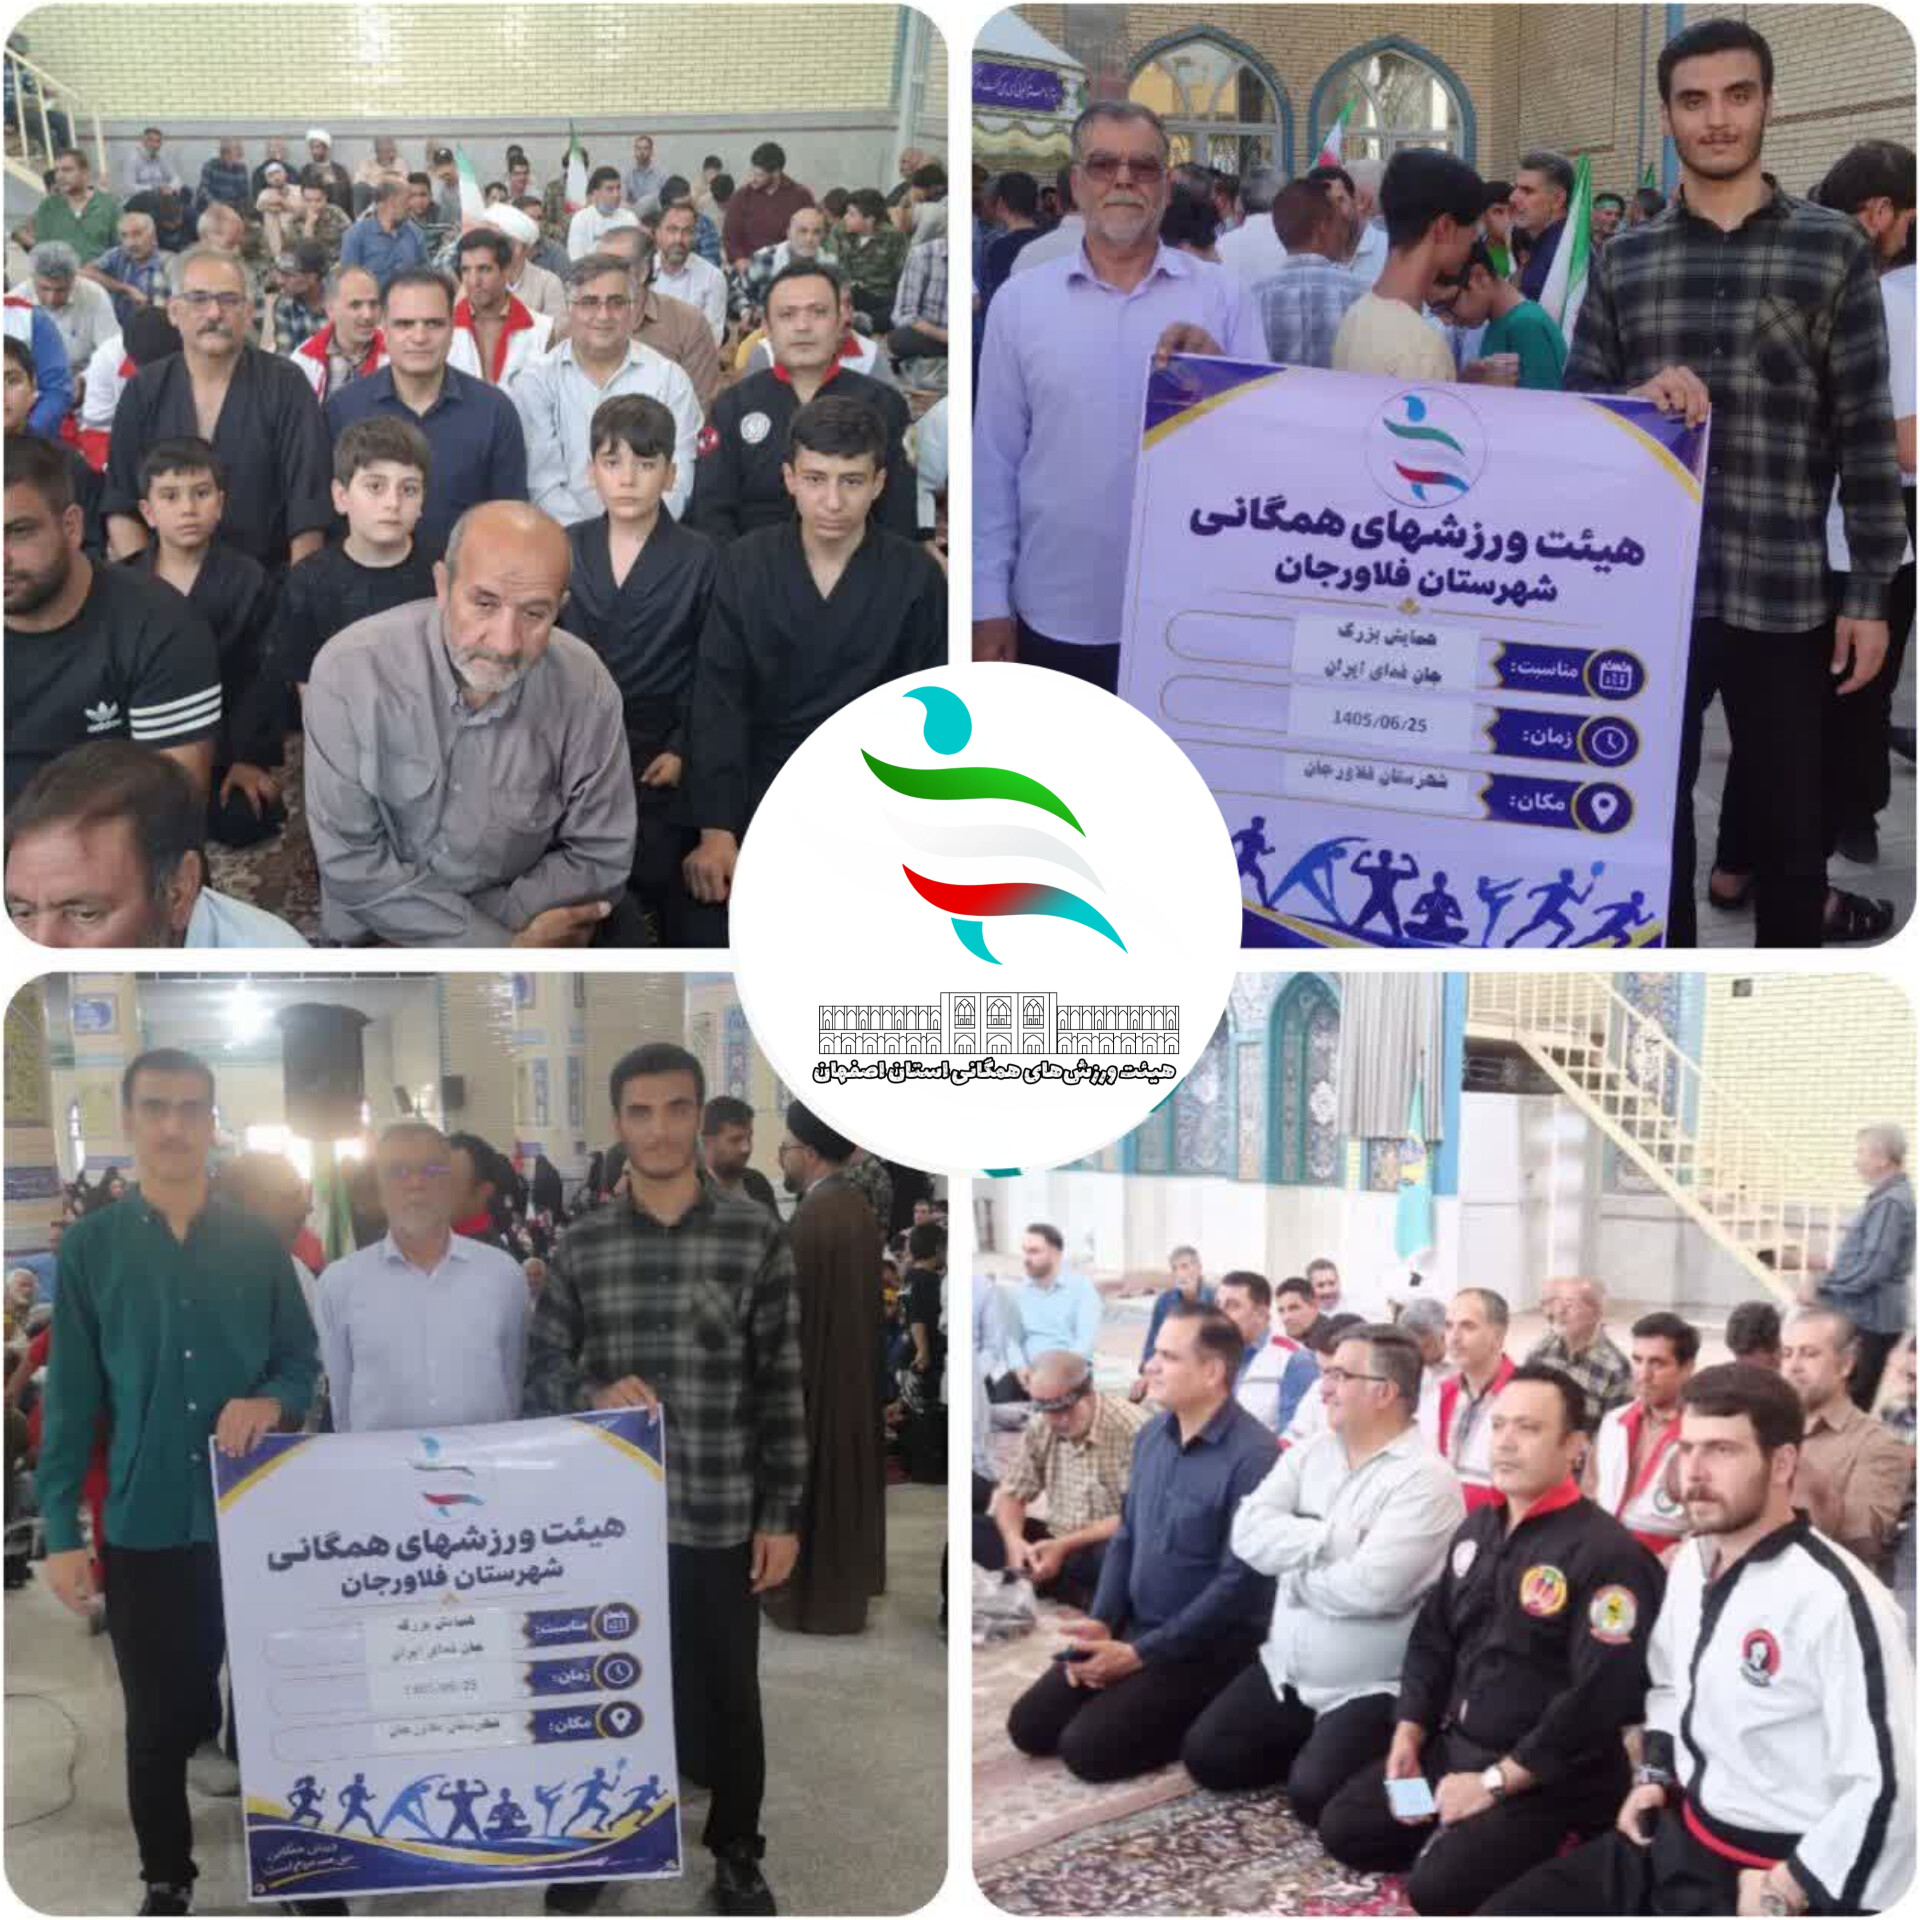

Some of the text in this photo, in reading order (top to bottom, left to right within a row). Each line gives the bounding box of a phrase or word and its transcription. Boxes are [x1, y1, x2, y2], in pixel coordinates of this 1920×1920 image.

[1190, 495, 1645, 573] هیئت ورزشهای همگانی
[1275, 553, 1558, 606] شهرستان فلاورجان
[1333, 709, 1428, 733] 1405/06/25
[267, 1517, 627, 1573] هیئت ورزشهای همگانی
[341, 1557, 565, 1598] شهرستان فلاورجان
